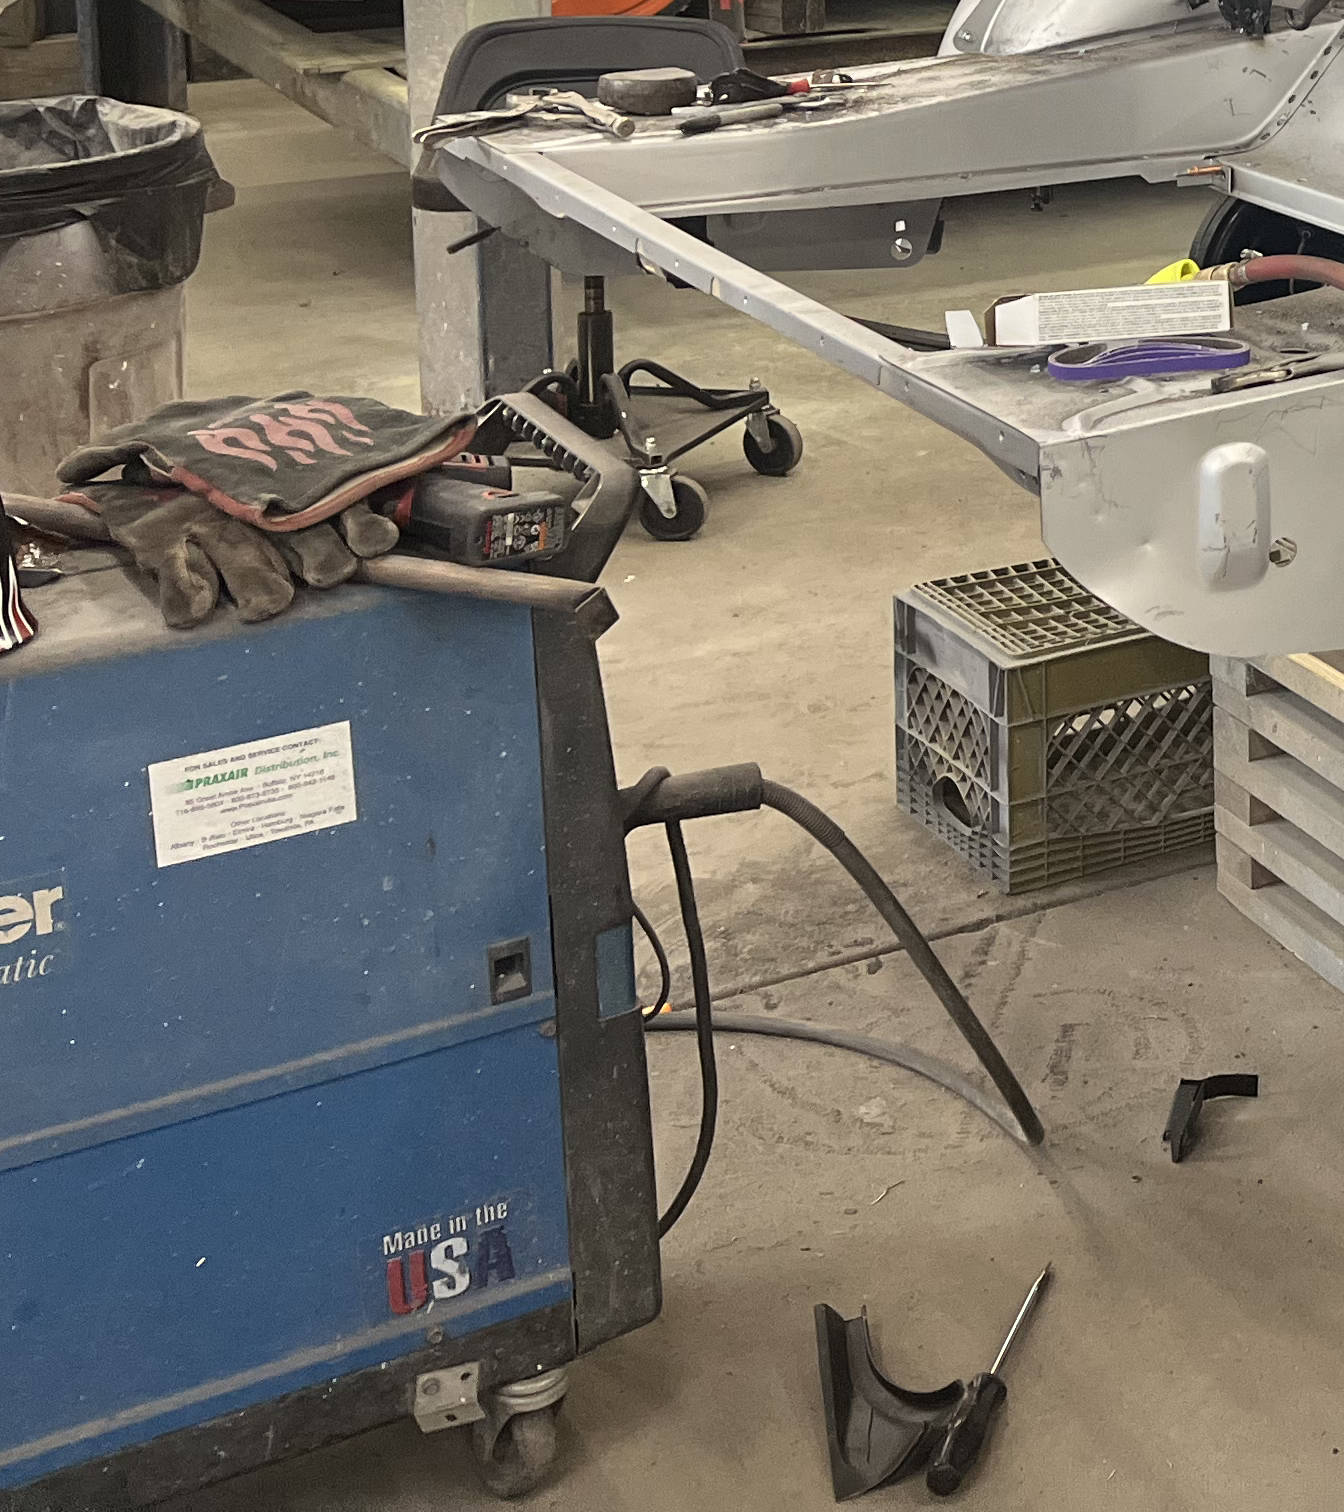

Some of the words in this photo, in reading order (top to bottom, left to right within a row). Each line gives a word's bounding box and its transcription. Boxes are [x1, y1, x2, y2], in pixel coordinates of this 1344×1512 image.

[194, 767, 249, 789] PRAXAIR
[254, 755, 320, 776] Distribution,
[322, 749, 340, 760] Inc.
[203, 758, 228, 769] SALES
[230, 754, 246, 764] AND
[248, 747, 280, 759] SERVICE
[171, 840, 194, 851] Albany
[0, 886, 63, 944] er
[383, 1222, 441, 1256] Made
[449, 1215, 467, 1234] in
[475, 1201, 508, 1226] the
[386, 1225, 516, 1315] USA
